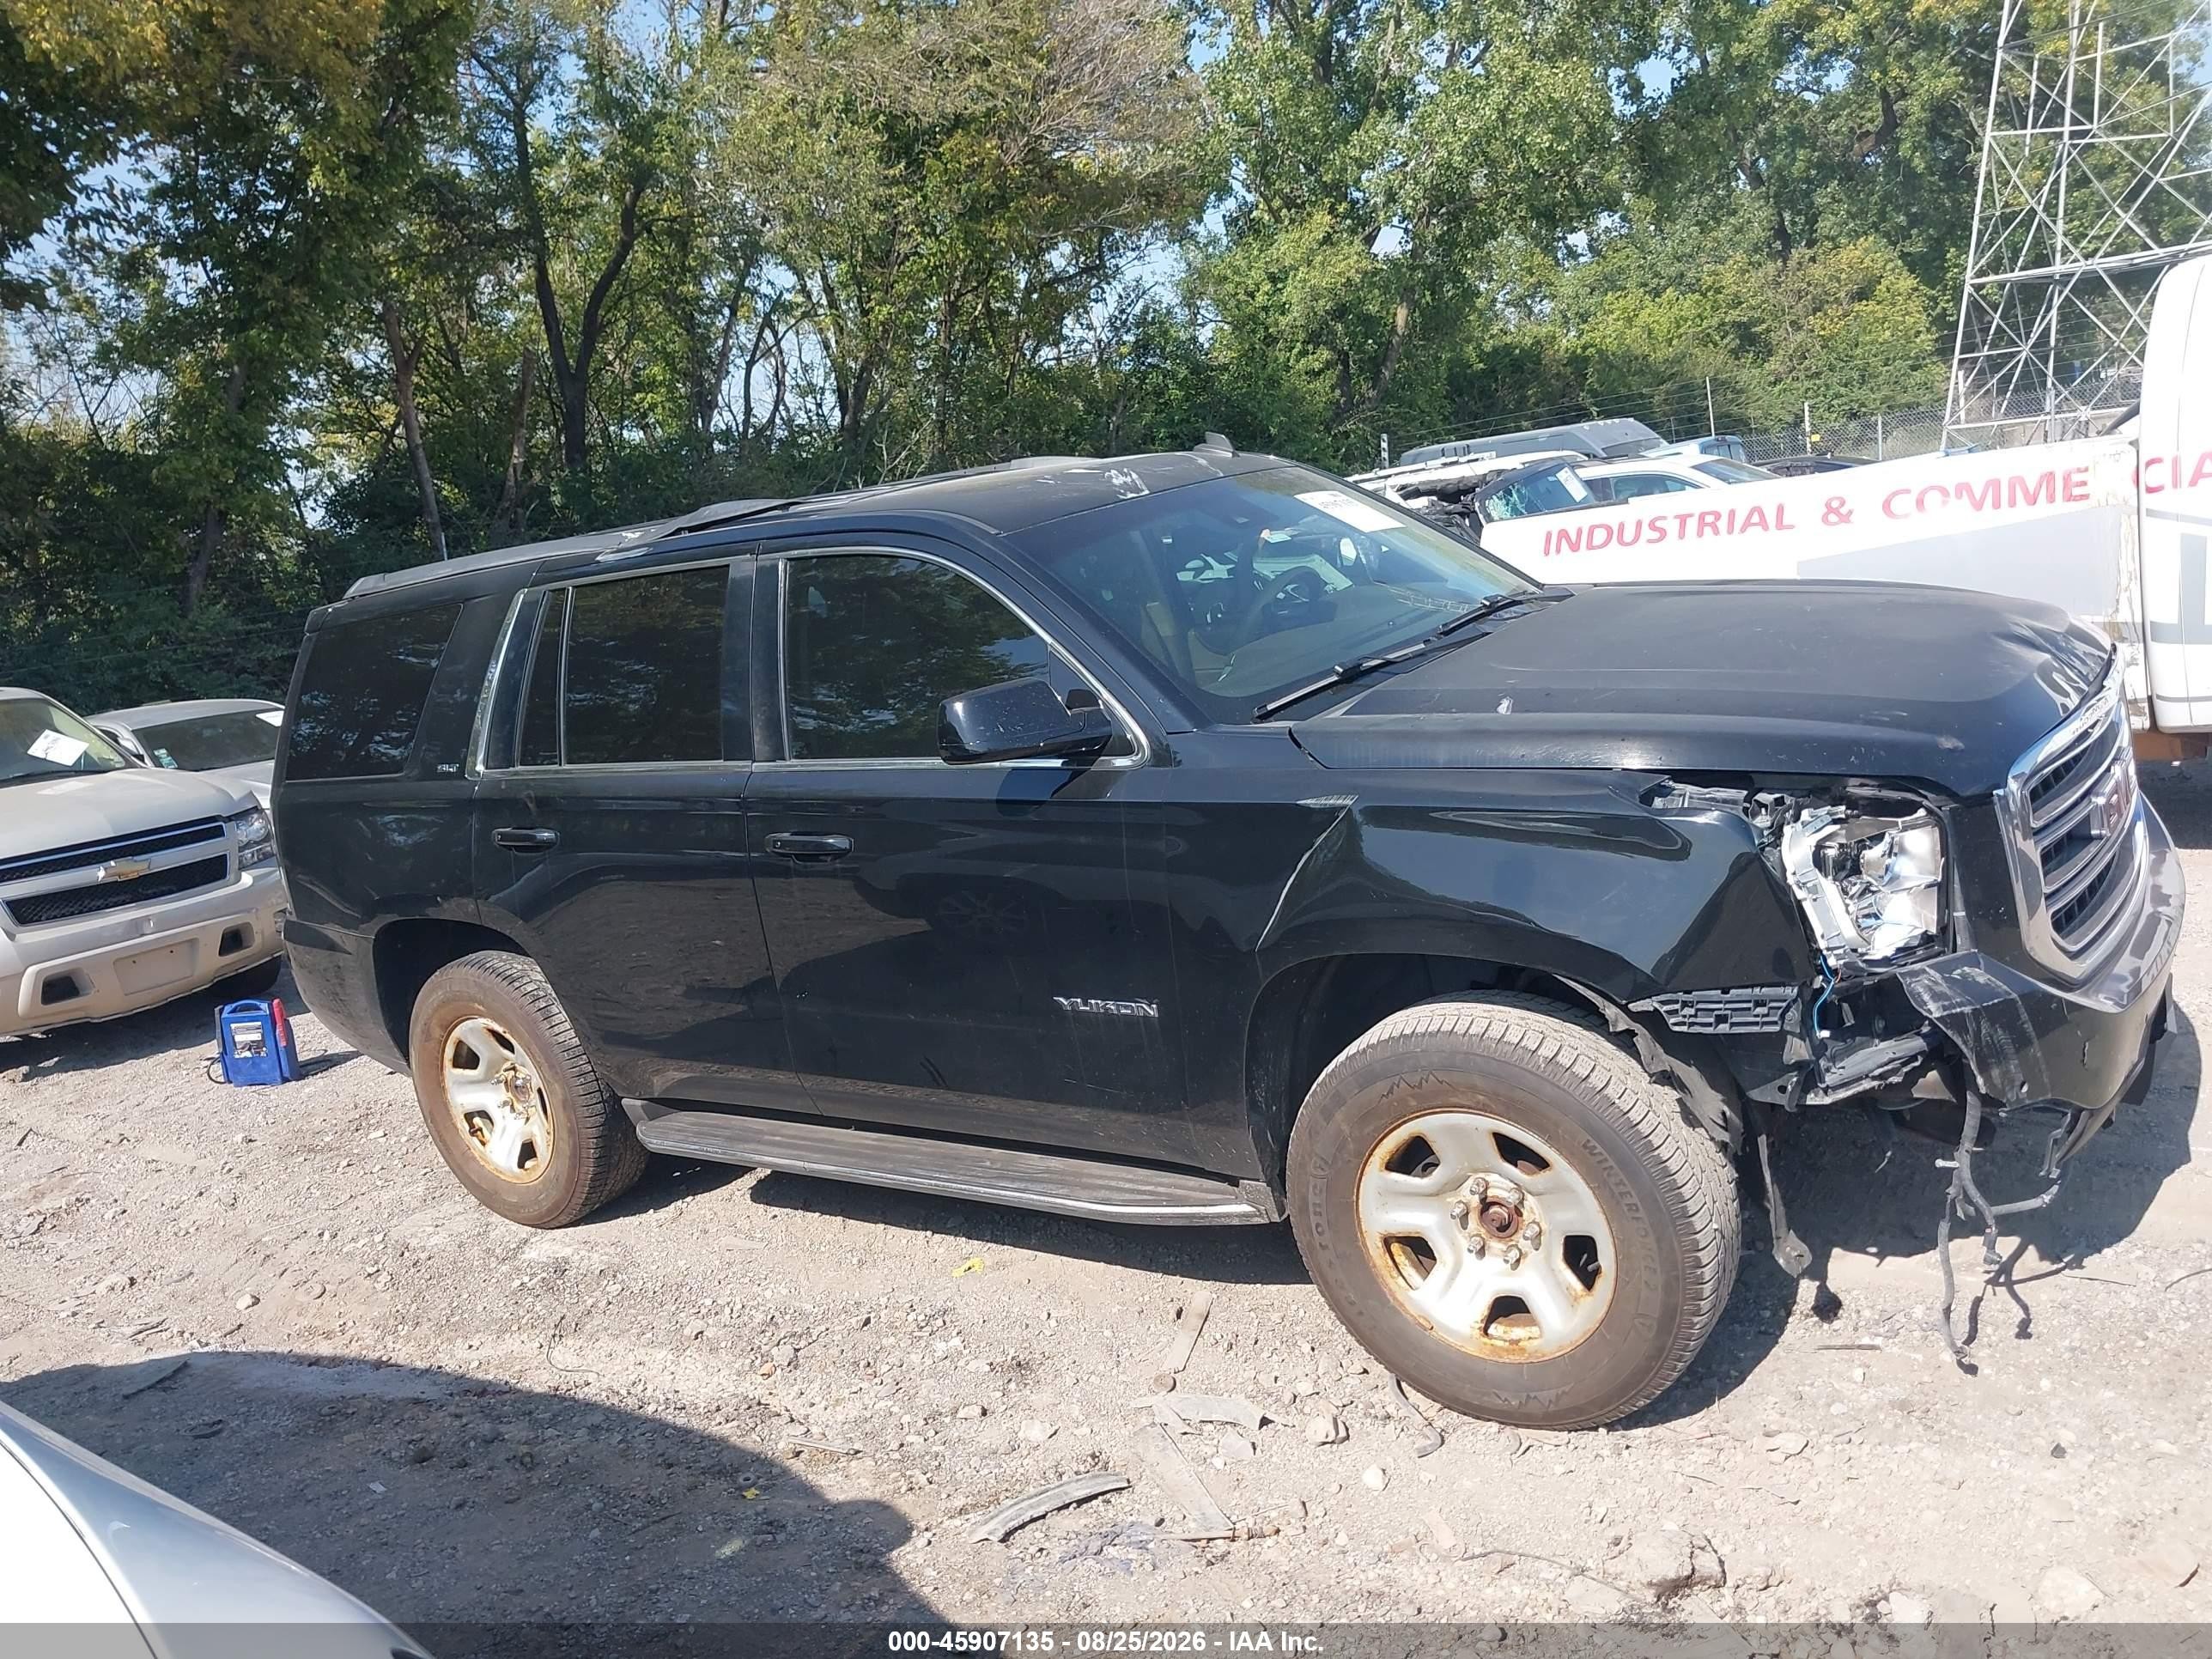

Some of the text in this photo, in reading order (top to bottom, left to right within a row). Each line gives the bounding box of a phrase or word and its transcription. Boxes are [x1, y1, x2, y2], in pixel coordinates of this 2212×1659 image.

[1542, 502, 1796, 556] INDUSTRIAL
[1821, 495, 1854, 526] &
[1053, 996, 1159, 1018] YUKON
